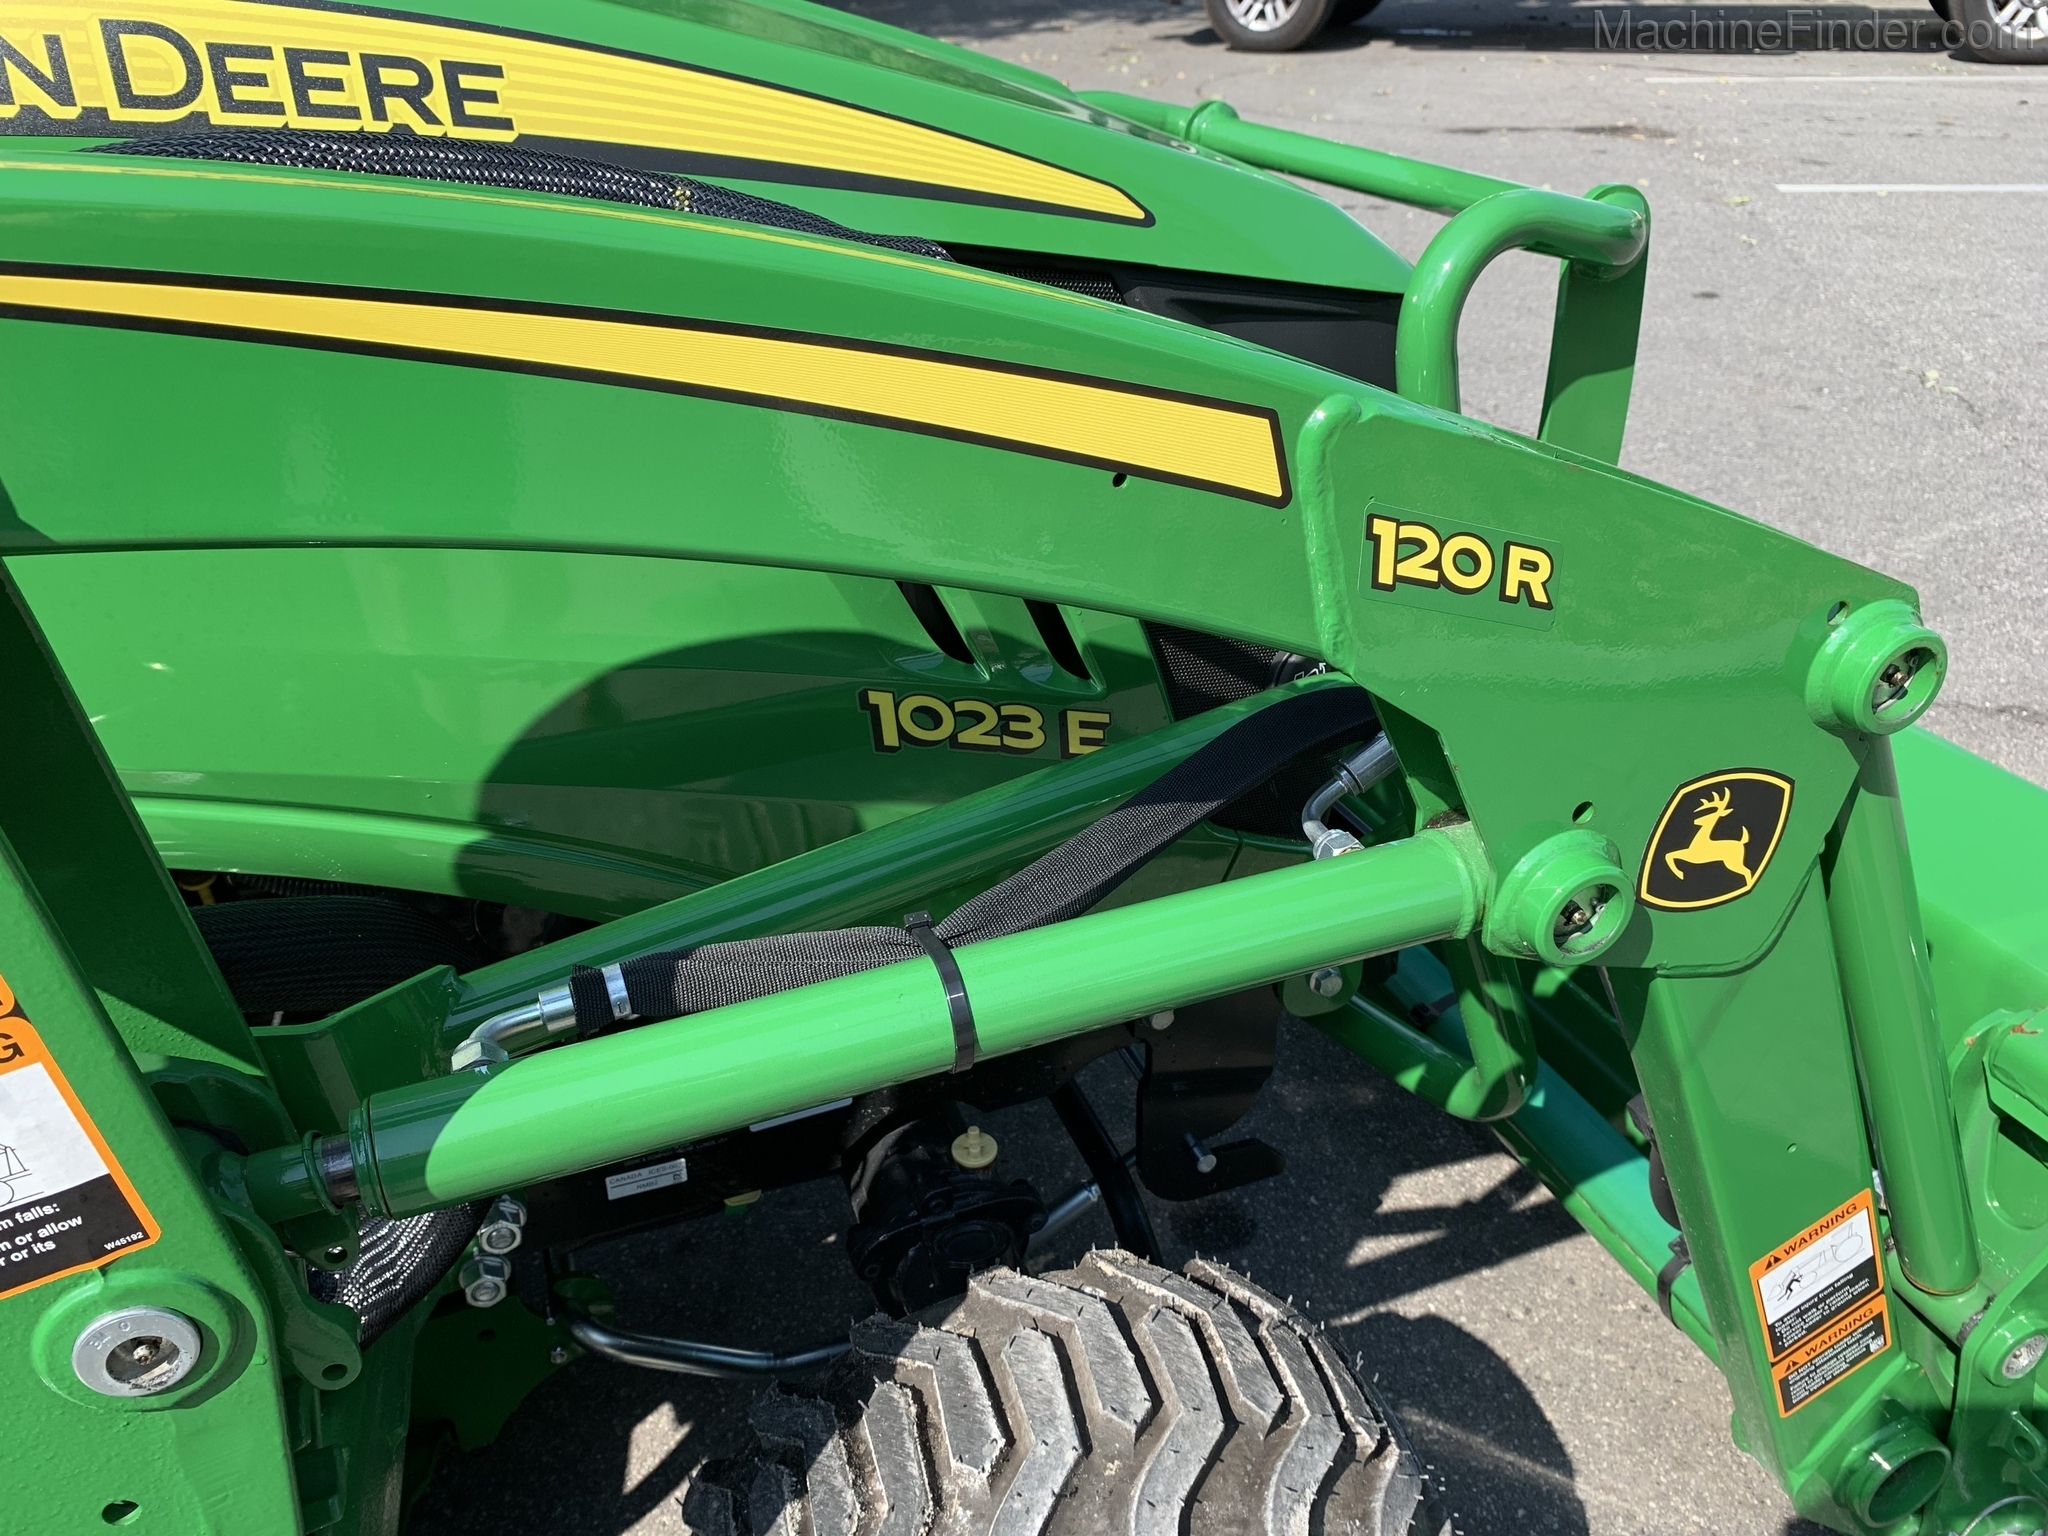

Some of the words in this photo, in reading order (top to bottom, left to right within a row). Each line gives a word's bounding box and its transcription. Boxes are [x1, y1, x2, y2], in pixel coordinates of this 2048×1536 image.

[98, 18, 515, 132] DEERE
[1366, 513, 1496, 596] 120
[1498, 540, 1554, 611] R
[858, 689, 1047, 755] 1023
[1058, 710, 1112, 760] E
[609, 1172, 643, 1185] CANADA
[15, 1203, 60, 1224] falls:
[15, 1232, 33, 1246] or
[37, 1215, 83, 1239] allow
[1783, 1203, 1857, 1256] WARNING
[10, 1249, 29, 1262] or
[32, 1239, 56, 1255] its
[104, 1231, 144, 1251] W45192
[1805, 1308, 1873, 1357] WARNING
